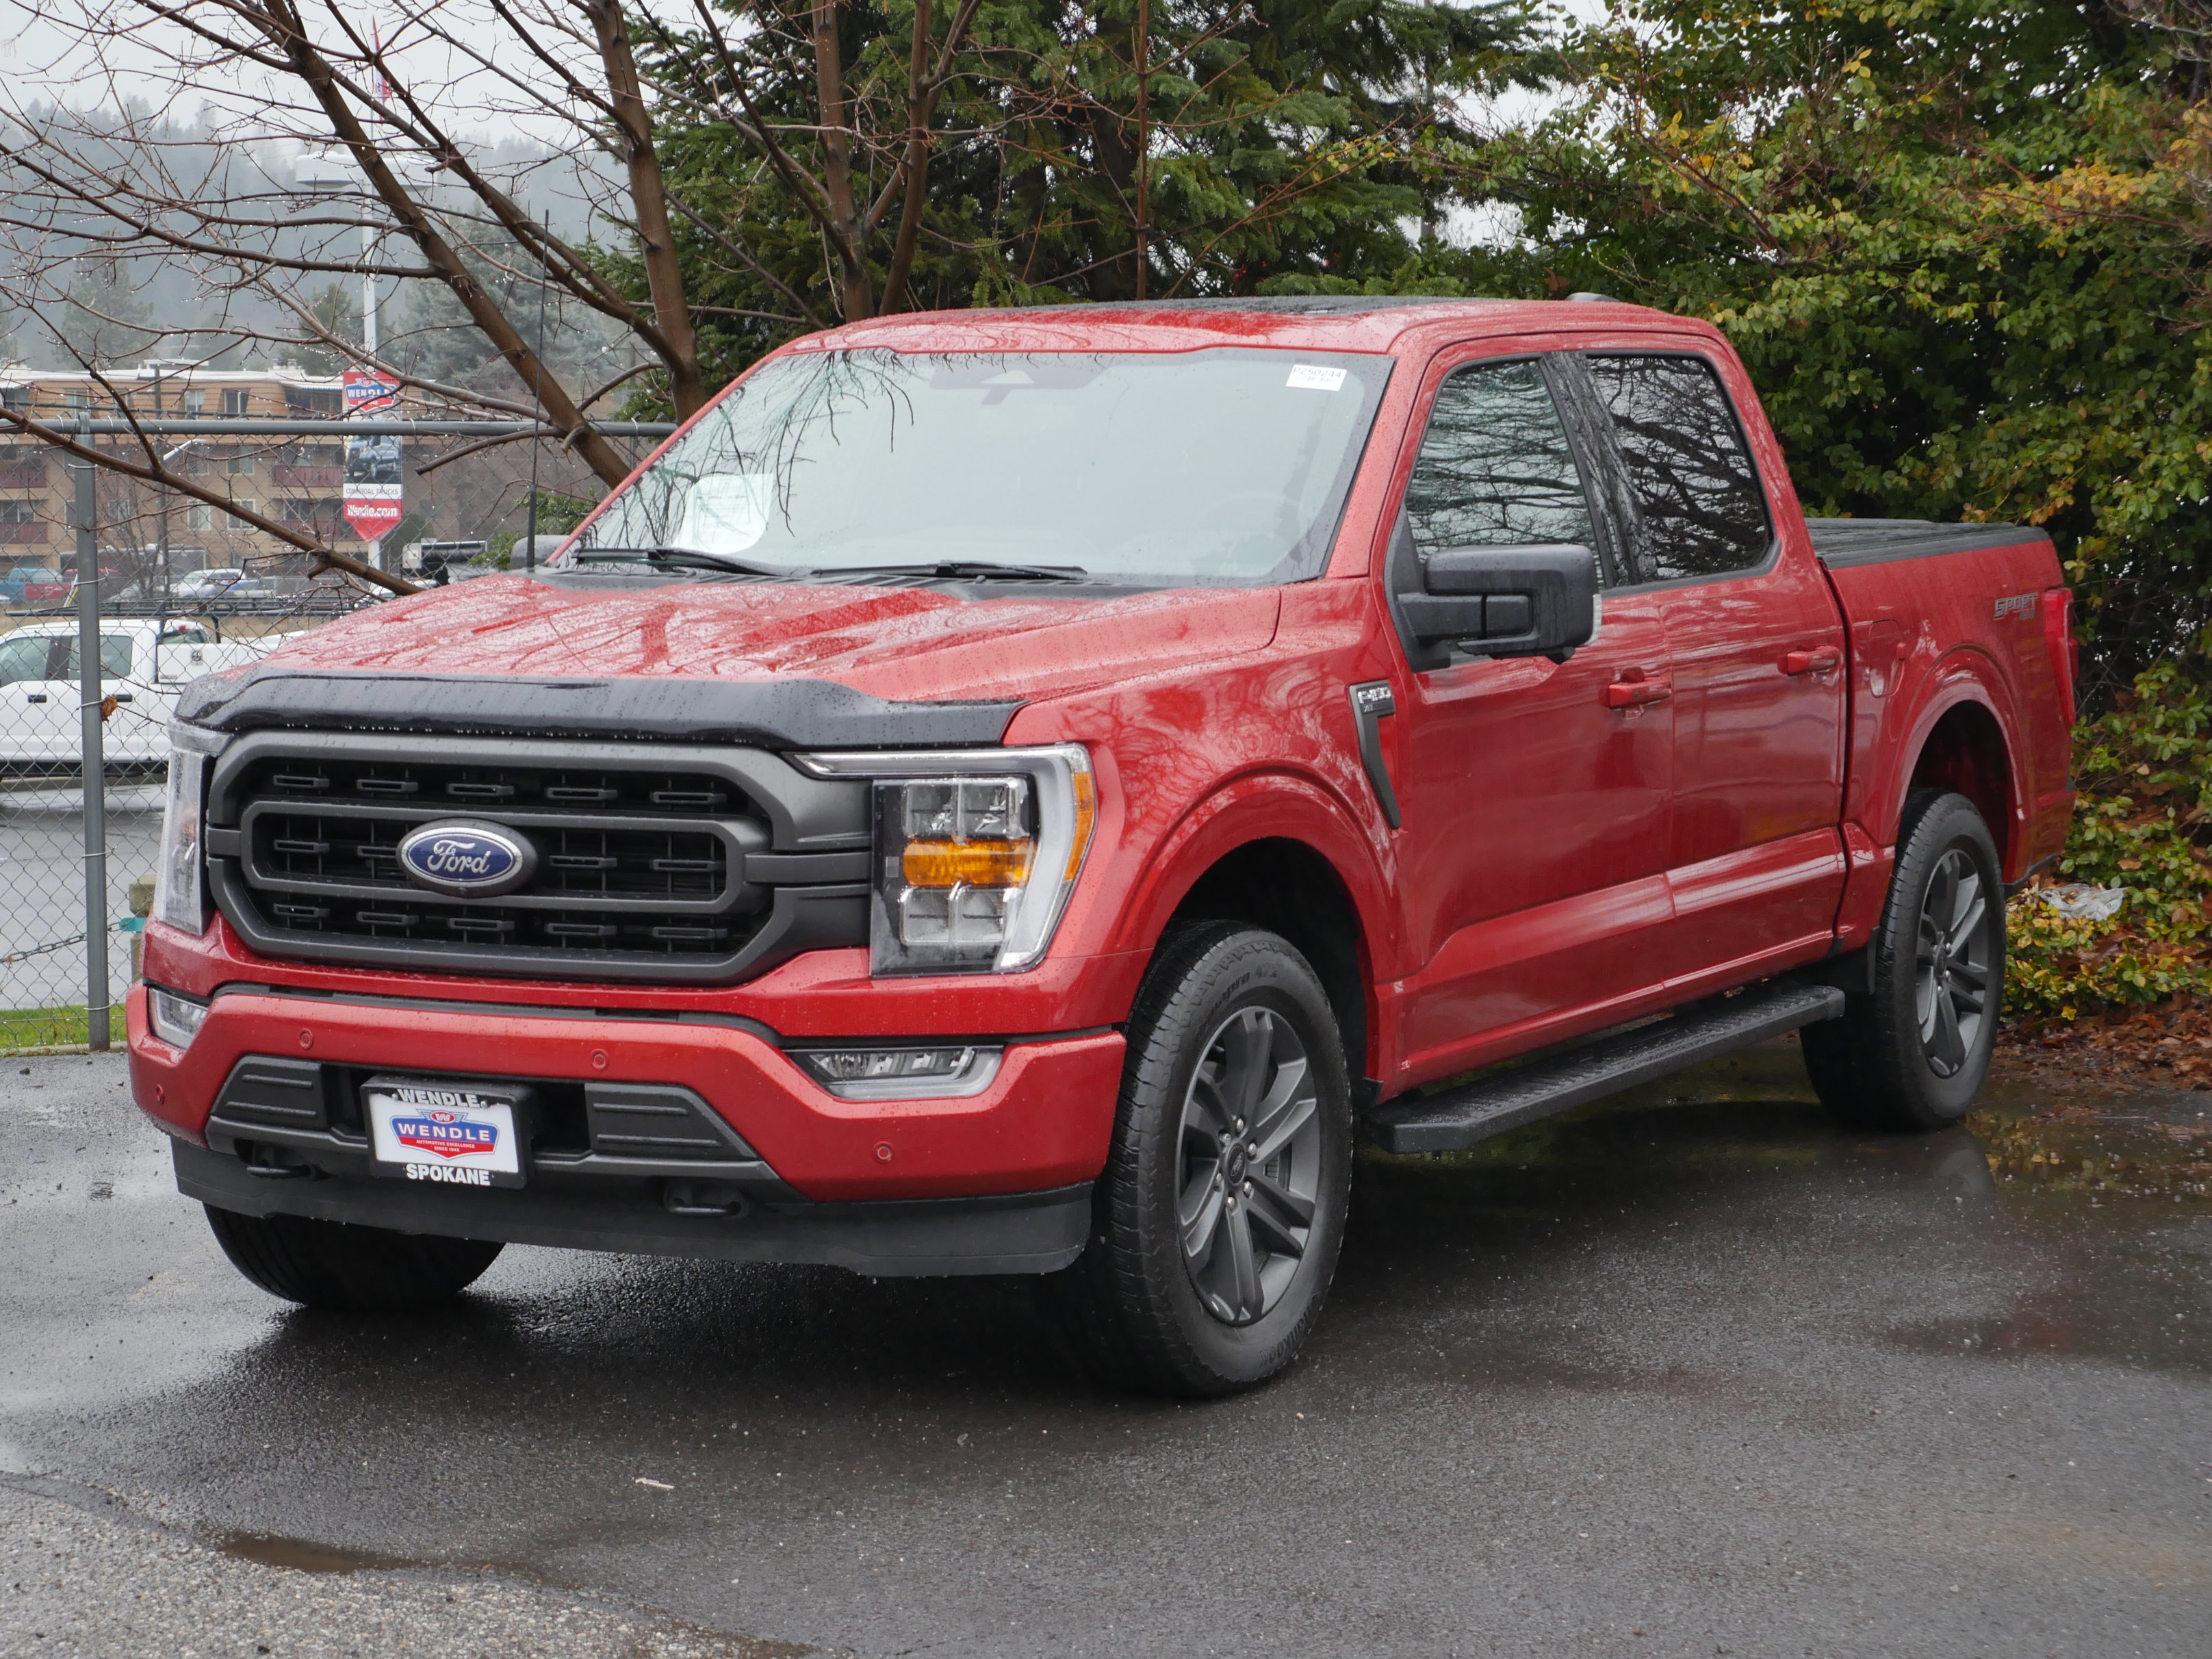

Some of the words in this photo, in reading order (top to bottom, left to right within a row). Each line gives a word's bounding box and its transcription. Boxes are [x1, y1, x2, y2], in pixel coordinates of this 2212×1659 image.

[1293, 366, 1342, 378] P250244
[346, 504, 397, 517] Wendle.com
[1994, 592, 2037, 619] SPORT
[427, 839, 491, 874] Ford
[397, 1088, 480, 1108] WENDLE
[398, 1122, 491, 1142] WENDLE
[406, 1163, 491, 1186] SPOKANE
